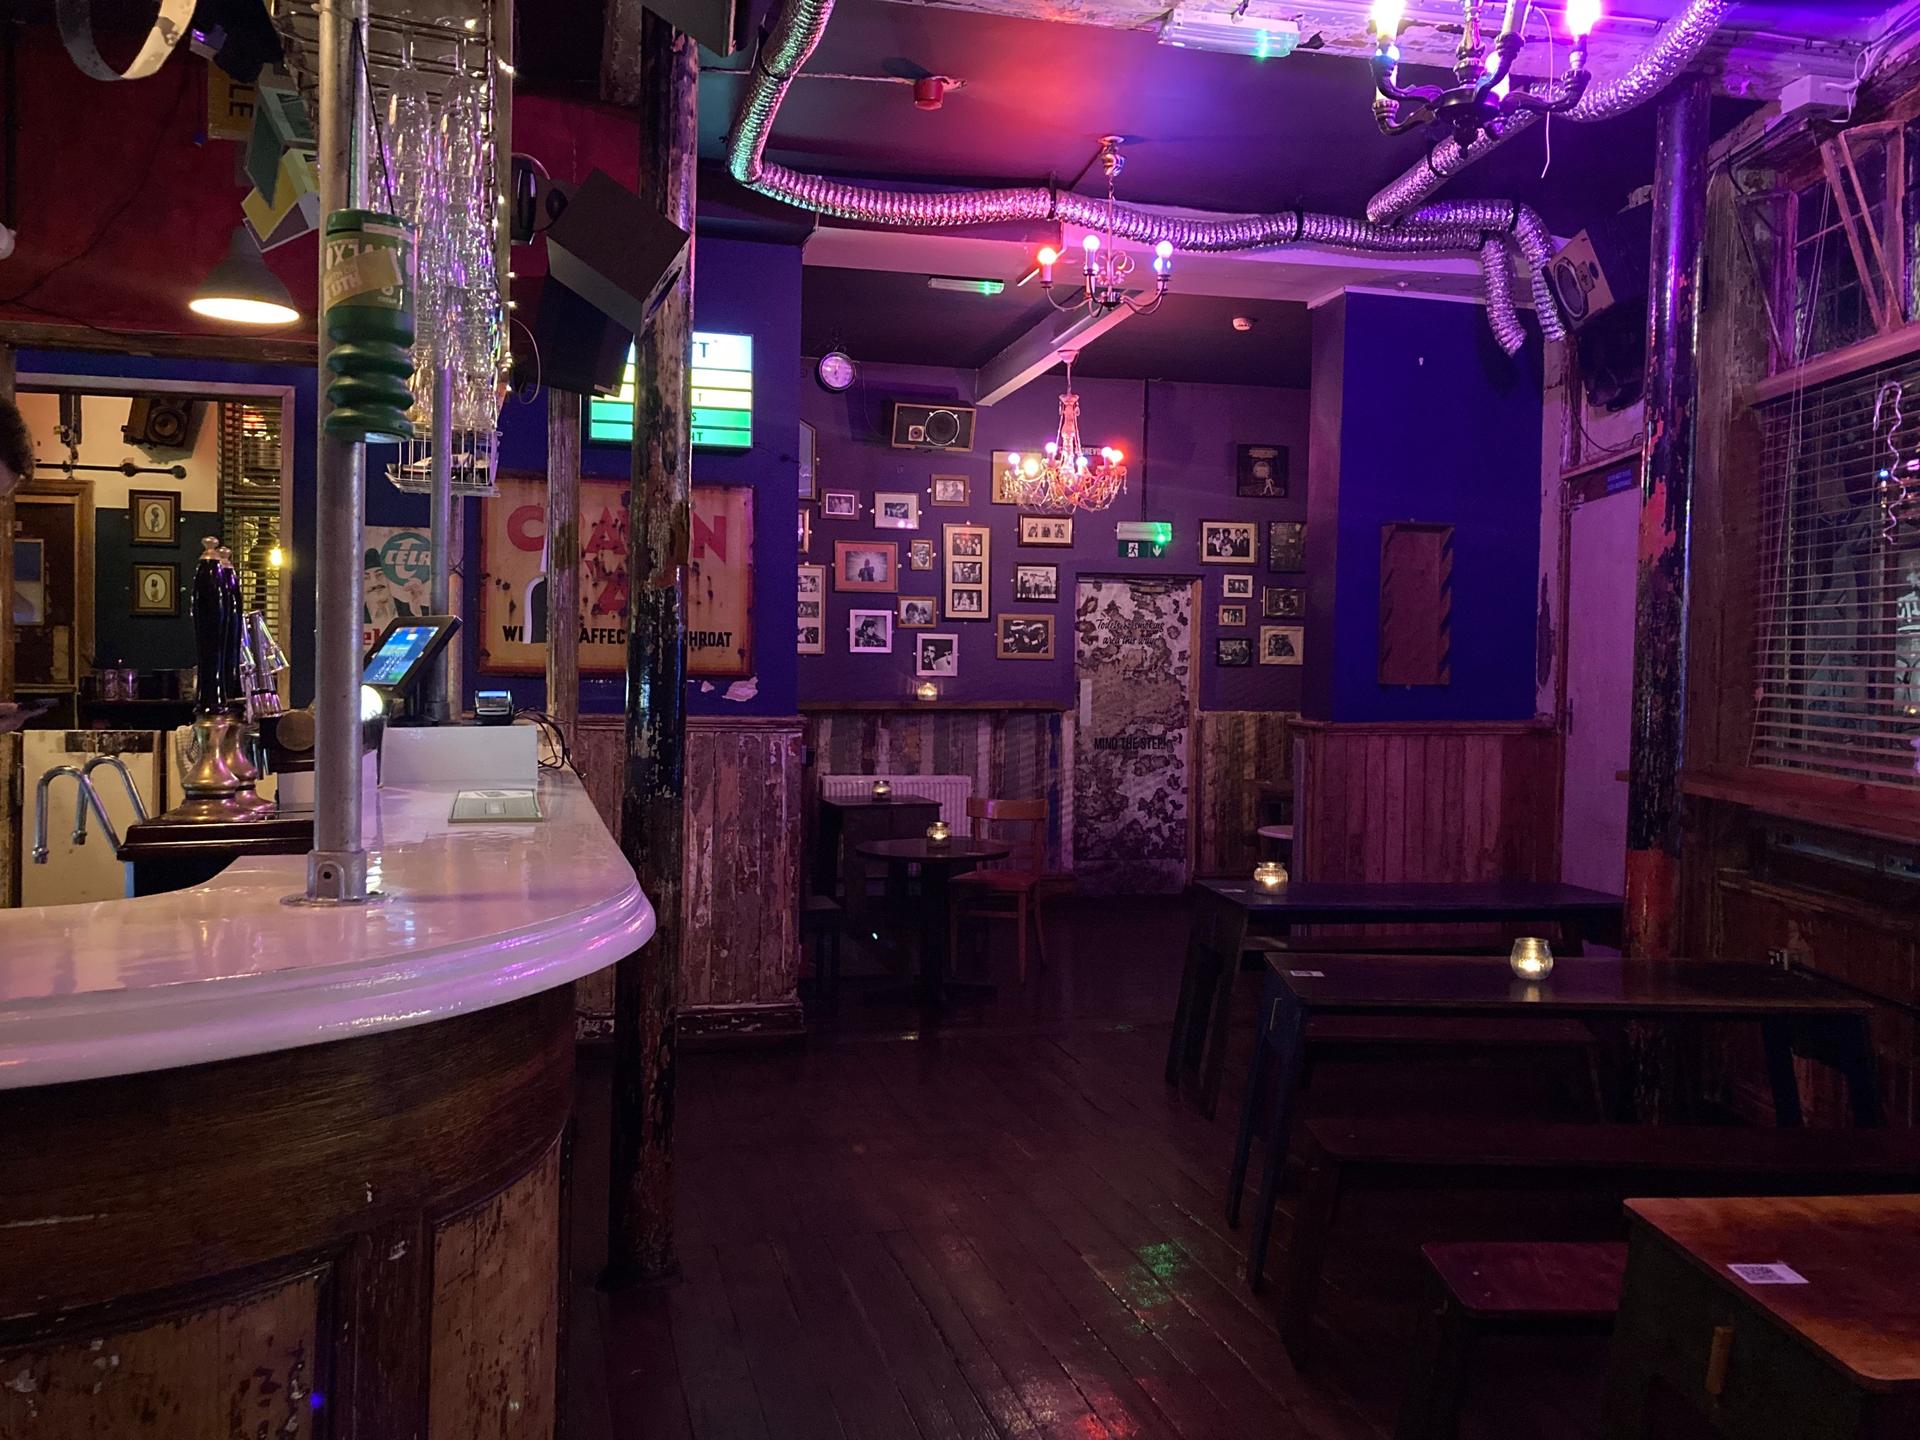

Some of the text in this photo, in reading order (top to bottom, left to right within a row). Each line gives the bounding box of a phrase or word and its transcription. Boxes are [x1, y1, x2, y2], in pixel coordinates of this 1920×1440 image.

[228, 83, 256, 117] LE
[503, 626, 733, 648] WI AFFEC HROAT
[1102, 636, 1119, 645] area
[1094, 737, 1118, 750] MIND
[1120, 737, 1138, 750] THE
